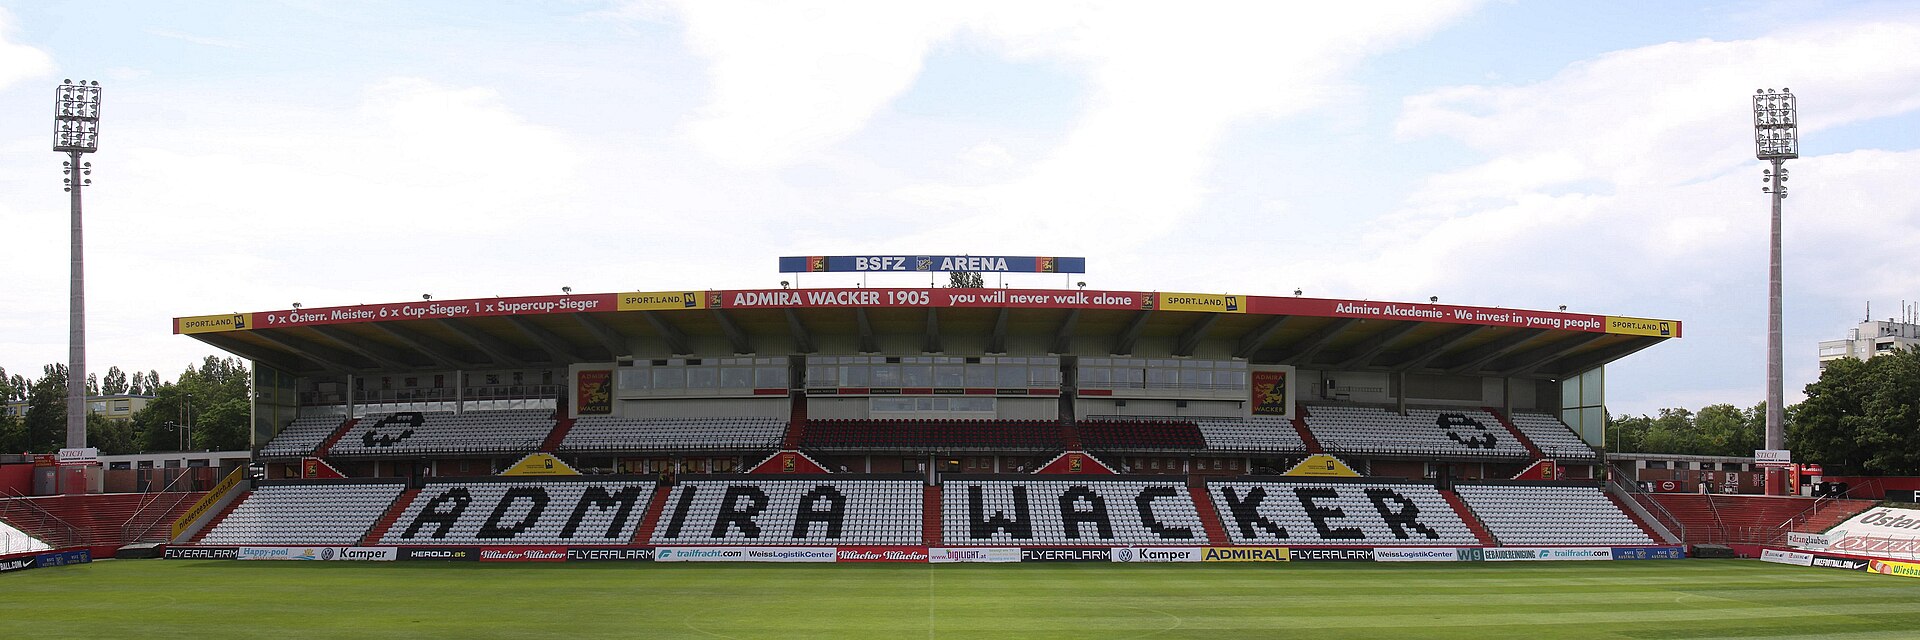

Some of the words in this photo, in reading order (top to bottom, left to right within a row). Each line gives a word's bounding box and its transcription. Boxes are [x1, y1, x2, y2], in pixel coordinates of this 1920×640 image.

[855, 257, 906, 270] BSFZ
[940, 257, 1009, 271] ARENA
[625, 296, 682, 305] SPORT.LAND.
[733, 292, 803, 306] ADMIRA
[807, 291, 881, 305] WACKER
[887, 290, 930, 305] 1905
[949, 294, 976, 307] you
[979, 291, 1006, 303] will
[1010, 294, 1050, 304] never
[1053, 292, 1089, 305] walk
[1093, 294, 1133, 306] alone
[1168, 297, 1224, 306] SPORT.LAND.
[267, 314, 274, 325] 9
[289, 308, 327, 323] Österr.
[331, 308, 375, 321] Meister,
[379, 306, 388, 317] 6
[391, 308, 399, 317] x
[402, 303, 470, 318] Cup-Sieger,
[475, 302, 480, 313] 1
[497, 297, 599, 314] Supercup-Sieger
[1335, 302, 1380, 315] Admira
[1383, 305, 1443, 319] Akademie
[1453, 309, 1473, 320] We
[1476, 309, 1510, 322] invest
[1512, 312, 1523, 323] in
[1526, 316, 1561, 327] young
[1563, 317, 1601, 330] people
[185, 319, 233, 328] SPORT.LAND.
[1612, 320, 1659, 331] SPORT.LAND.
[179, 478, 234, 530] niederoesterreich.at
[400, 486, 847, 539] ADMIRA
[967, 486, 1440, 539] WACKER
[164, 549, 238, 560] FLYERALARM
[243, 547, 289, 557] Happy-pool
[339, 547, 387, 560] Kamper
[411, 550, 466, 558] HEROLD.at
[567, 550, 654, 560] FLYERALARM
[676, 549, 742, 558] trailfracht.com
[748, 550, 834, 560] WeissLogistikCenter
[1021, 550, 1111, 560] FLYERALARM
[1139, 548, 1191, 561] Kamper
[1205, 548, 1287, 561] ADMIRAL
[1290, 550, 1374, 560] FLYERALARM
[1377, 550, 1453, 560] WeissLogistikCenter
[1554, 549, 1609, 558] trailfracht.com
